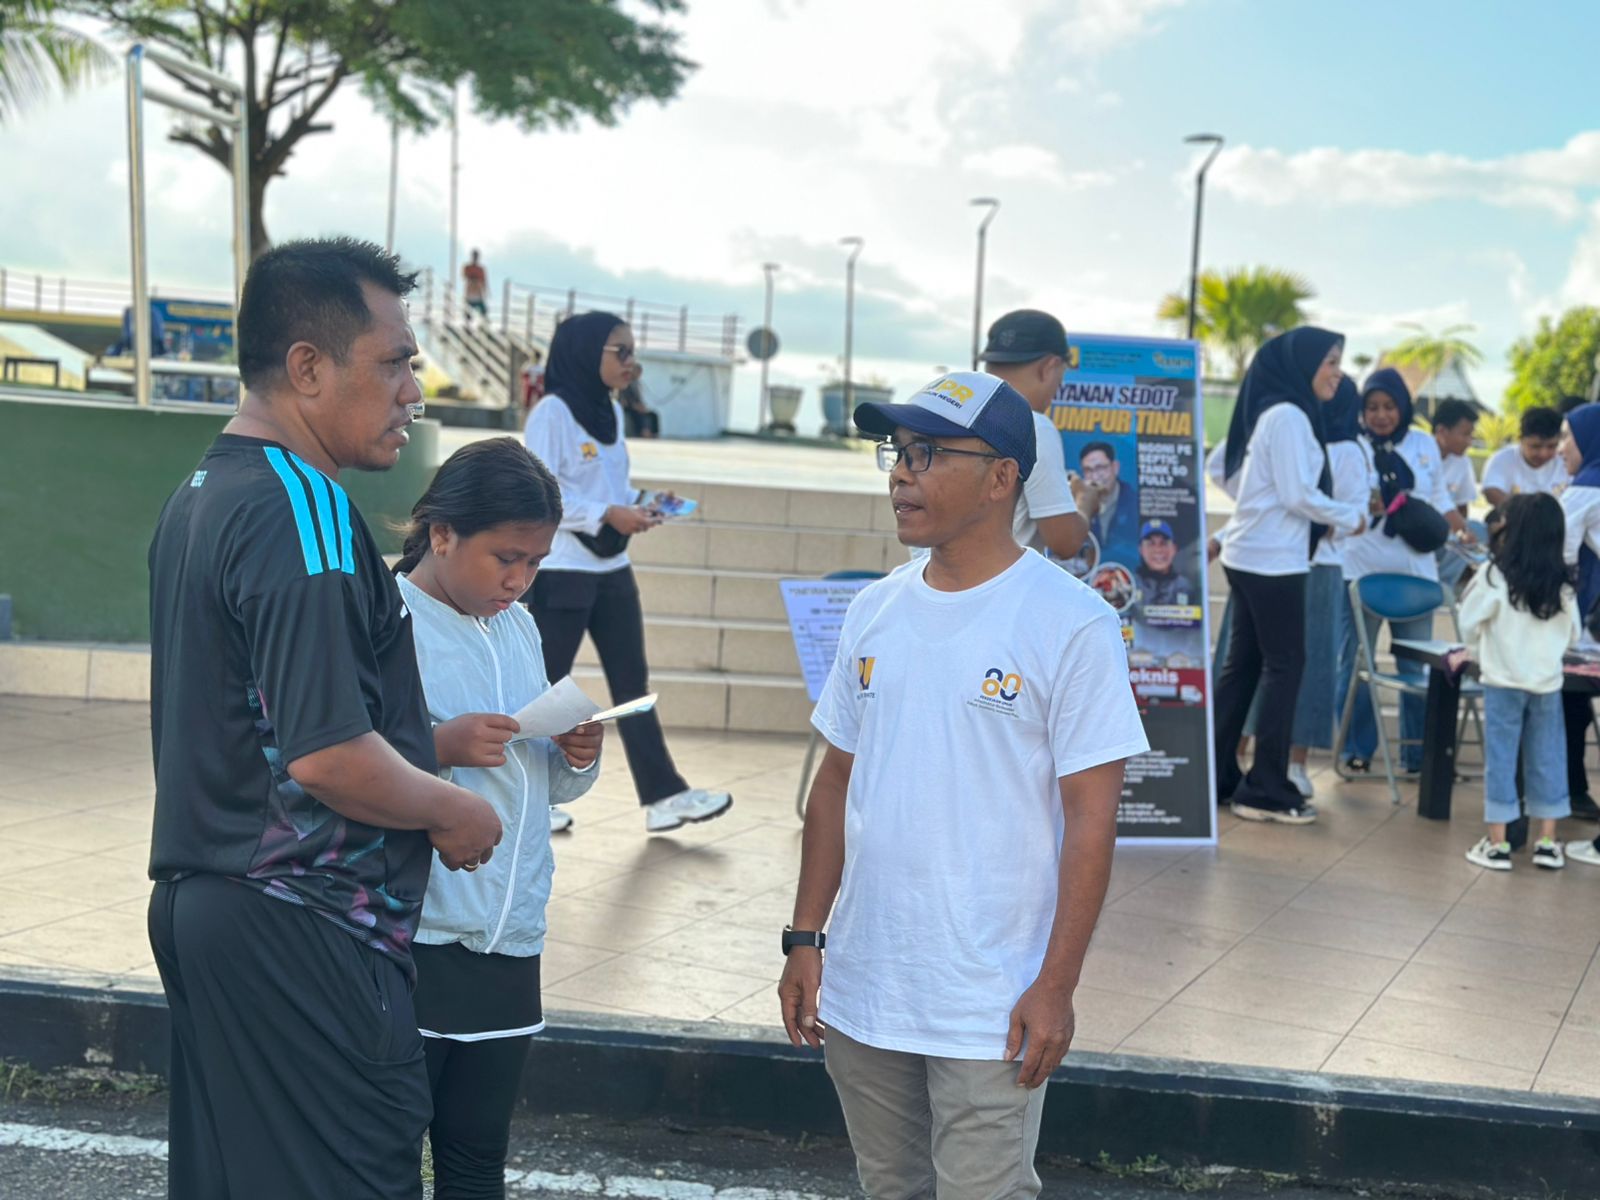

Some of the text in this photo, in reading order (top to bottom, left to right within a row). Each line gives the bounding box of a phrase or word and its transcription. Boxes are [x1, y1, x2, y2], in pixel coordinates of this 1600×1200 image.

[938, 394, 962, 409] NEGERI
[1117, 386, 1178, 409] SEDOT
[1046, 405, 1192, 436] UMPUR TINJA
[1138, 454, 1179, 465] SEPTIC
[1139, 464, 1170, 475] TANK
[982, 667, 1022, 701] 80
[1129, 667, 1179, 684] eknis
